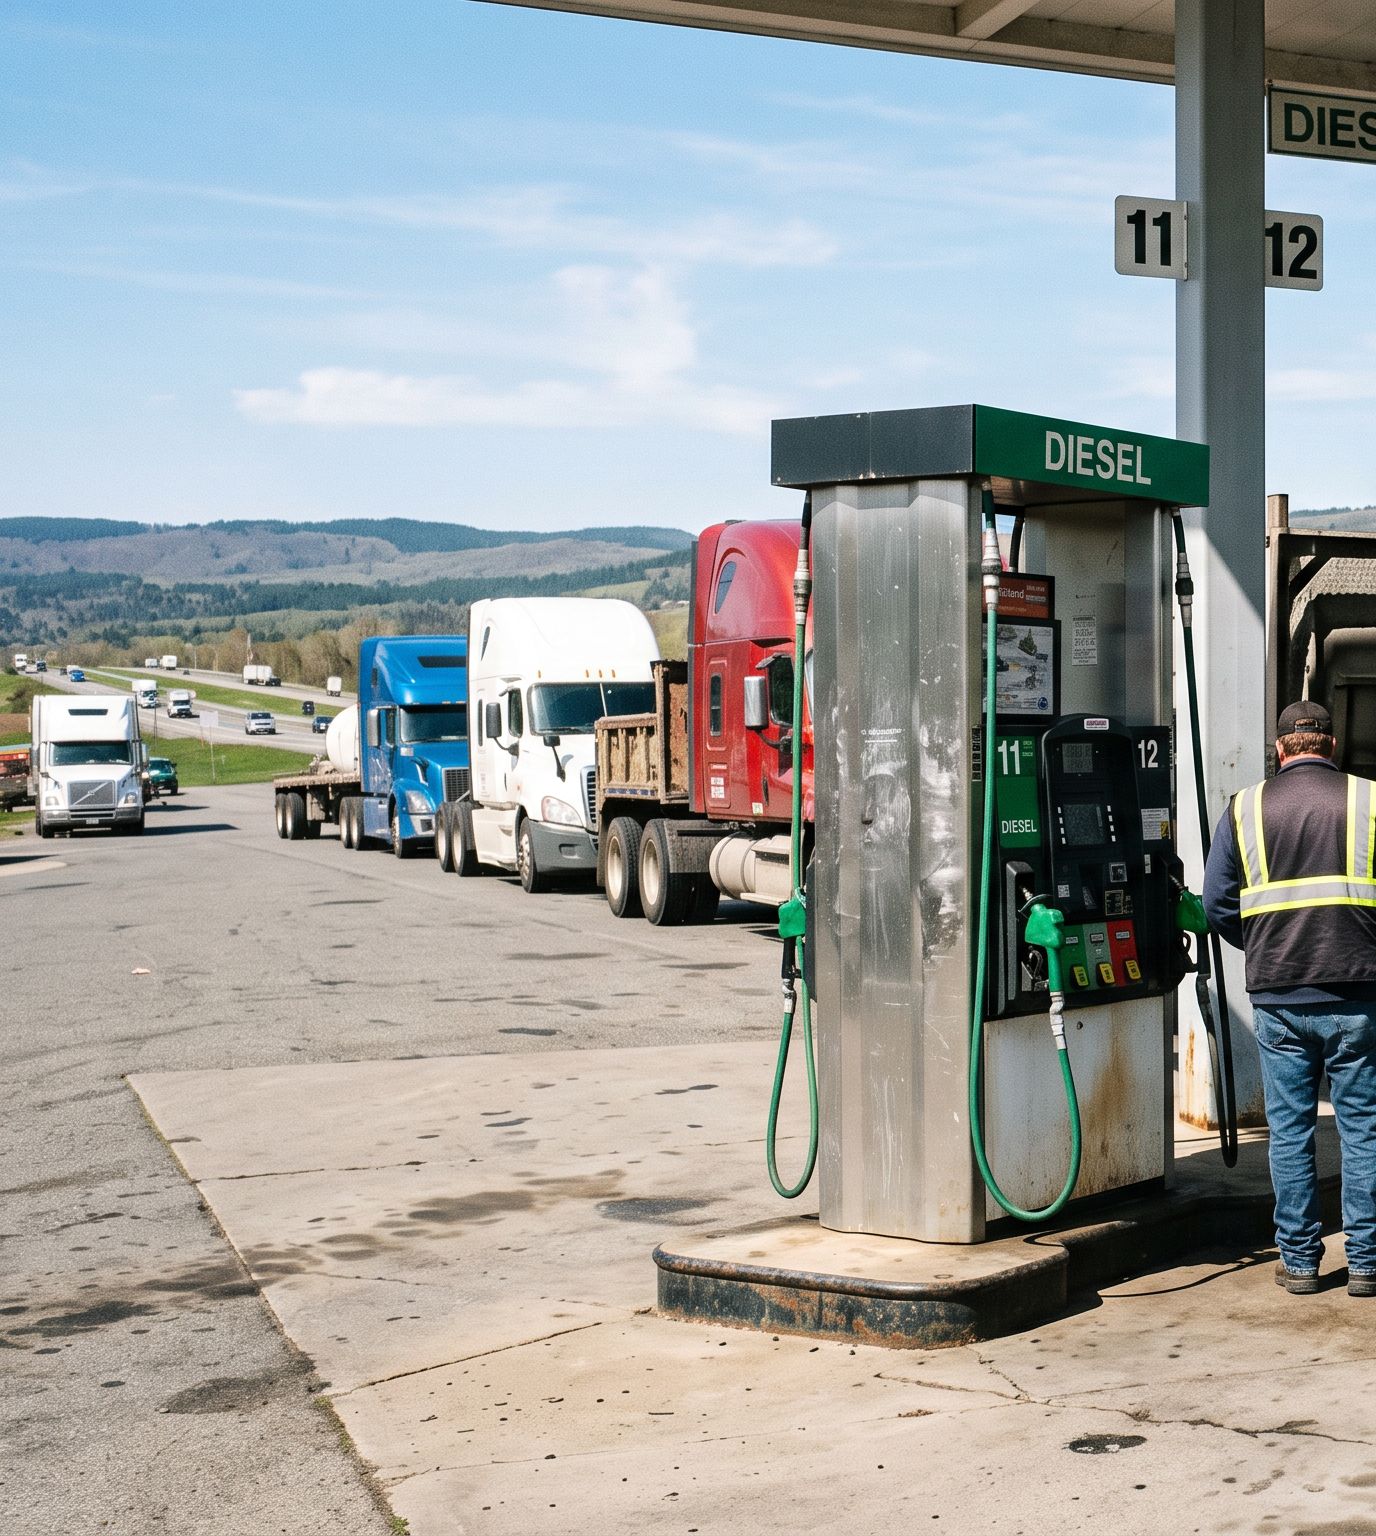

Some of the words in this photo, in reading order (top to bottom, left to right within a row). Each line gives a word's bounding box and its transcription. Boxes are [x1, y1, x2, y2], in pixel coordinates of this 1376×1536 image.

[1126, 209, 1172, 266] 11
[1265, 222, 1318, 279] 12
[1045, 430, 1152, 485] DIESEL
[997, 740, 1021, 775] 11
[1137, 739, 1159, 769] 12
[1001, 819, 1037, 834] DIESEL
